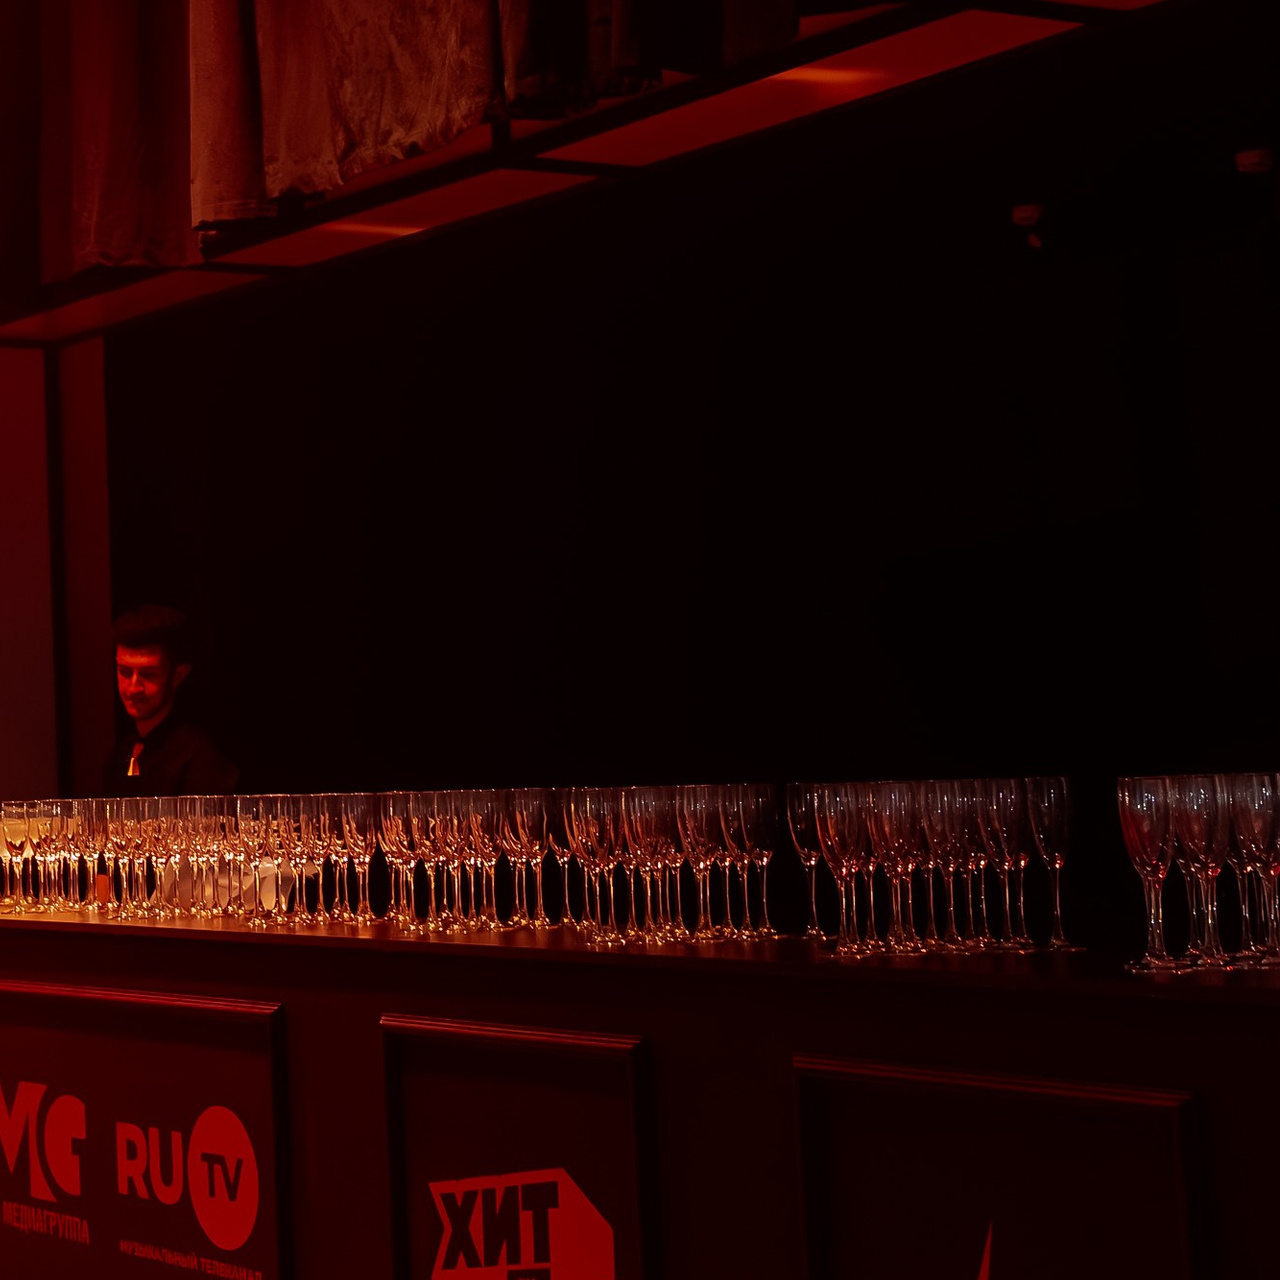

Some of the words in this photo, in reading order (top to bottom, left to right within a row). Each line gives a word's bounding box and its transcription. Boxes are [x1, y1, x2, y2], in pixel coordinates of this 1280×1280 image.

[116, 1121, 183, 1205] RU
[201, 1152, 243, 1202] TV
[3, 1201, 90, 1244] МЕДИАГРУППА
[439, 1181, 559, 1270] ХИТ
[119, 1240, 198, 1270] МУЗЫКАЛЬНЫЙ
